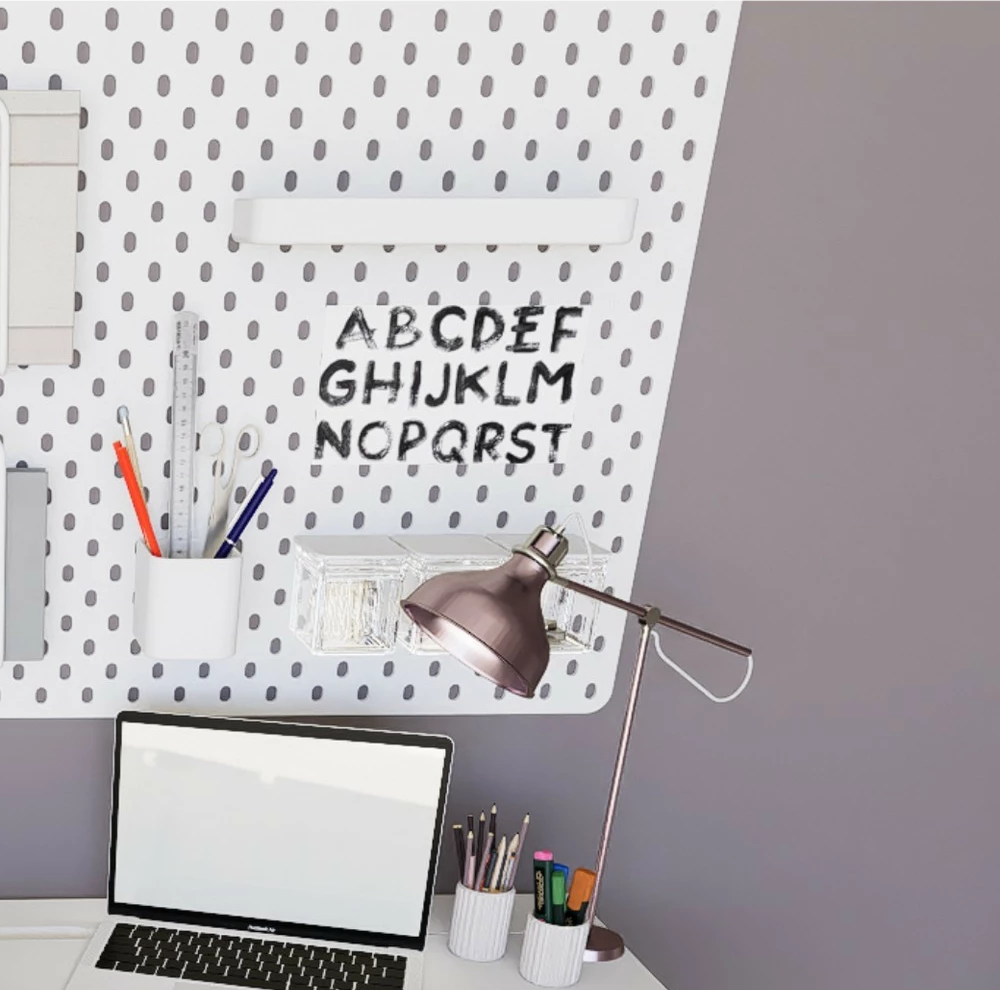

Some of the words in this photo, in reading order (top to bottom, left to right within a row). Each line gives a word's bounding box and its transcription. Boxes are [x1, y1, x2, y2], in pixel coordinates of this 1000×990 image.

[335, 304, 584, 354] ABCDEF
[318, 360, 577, 408] GHIJKLM
[314, 419, 572, 465] NOPQRST
